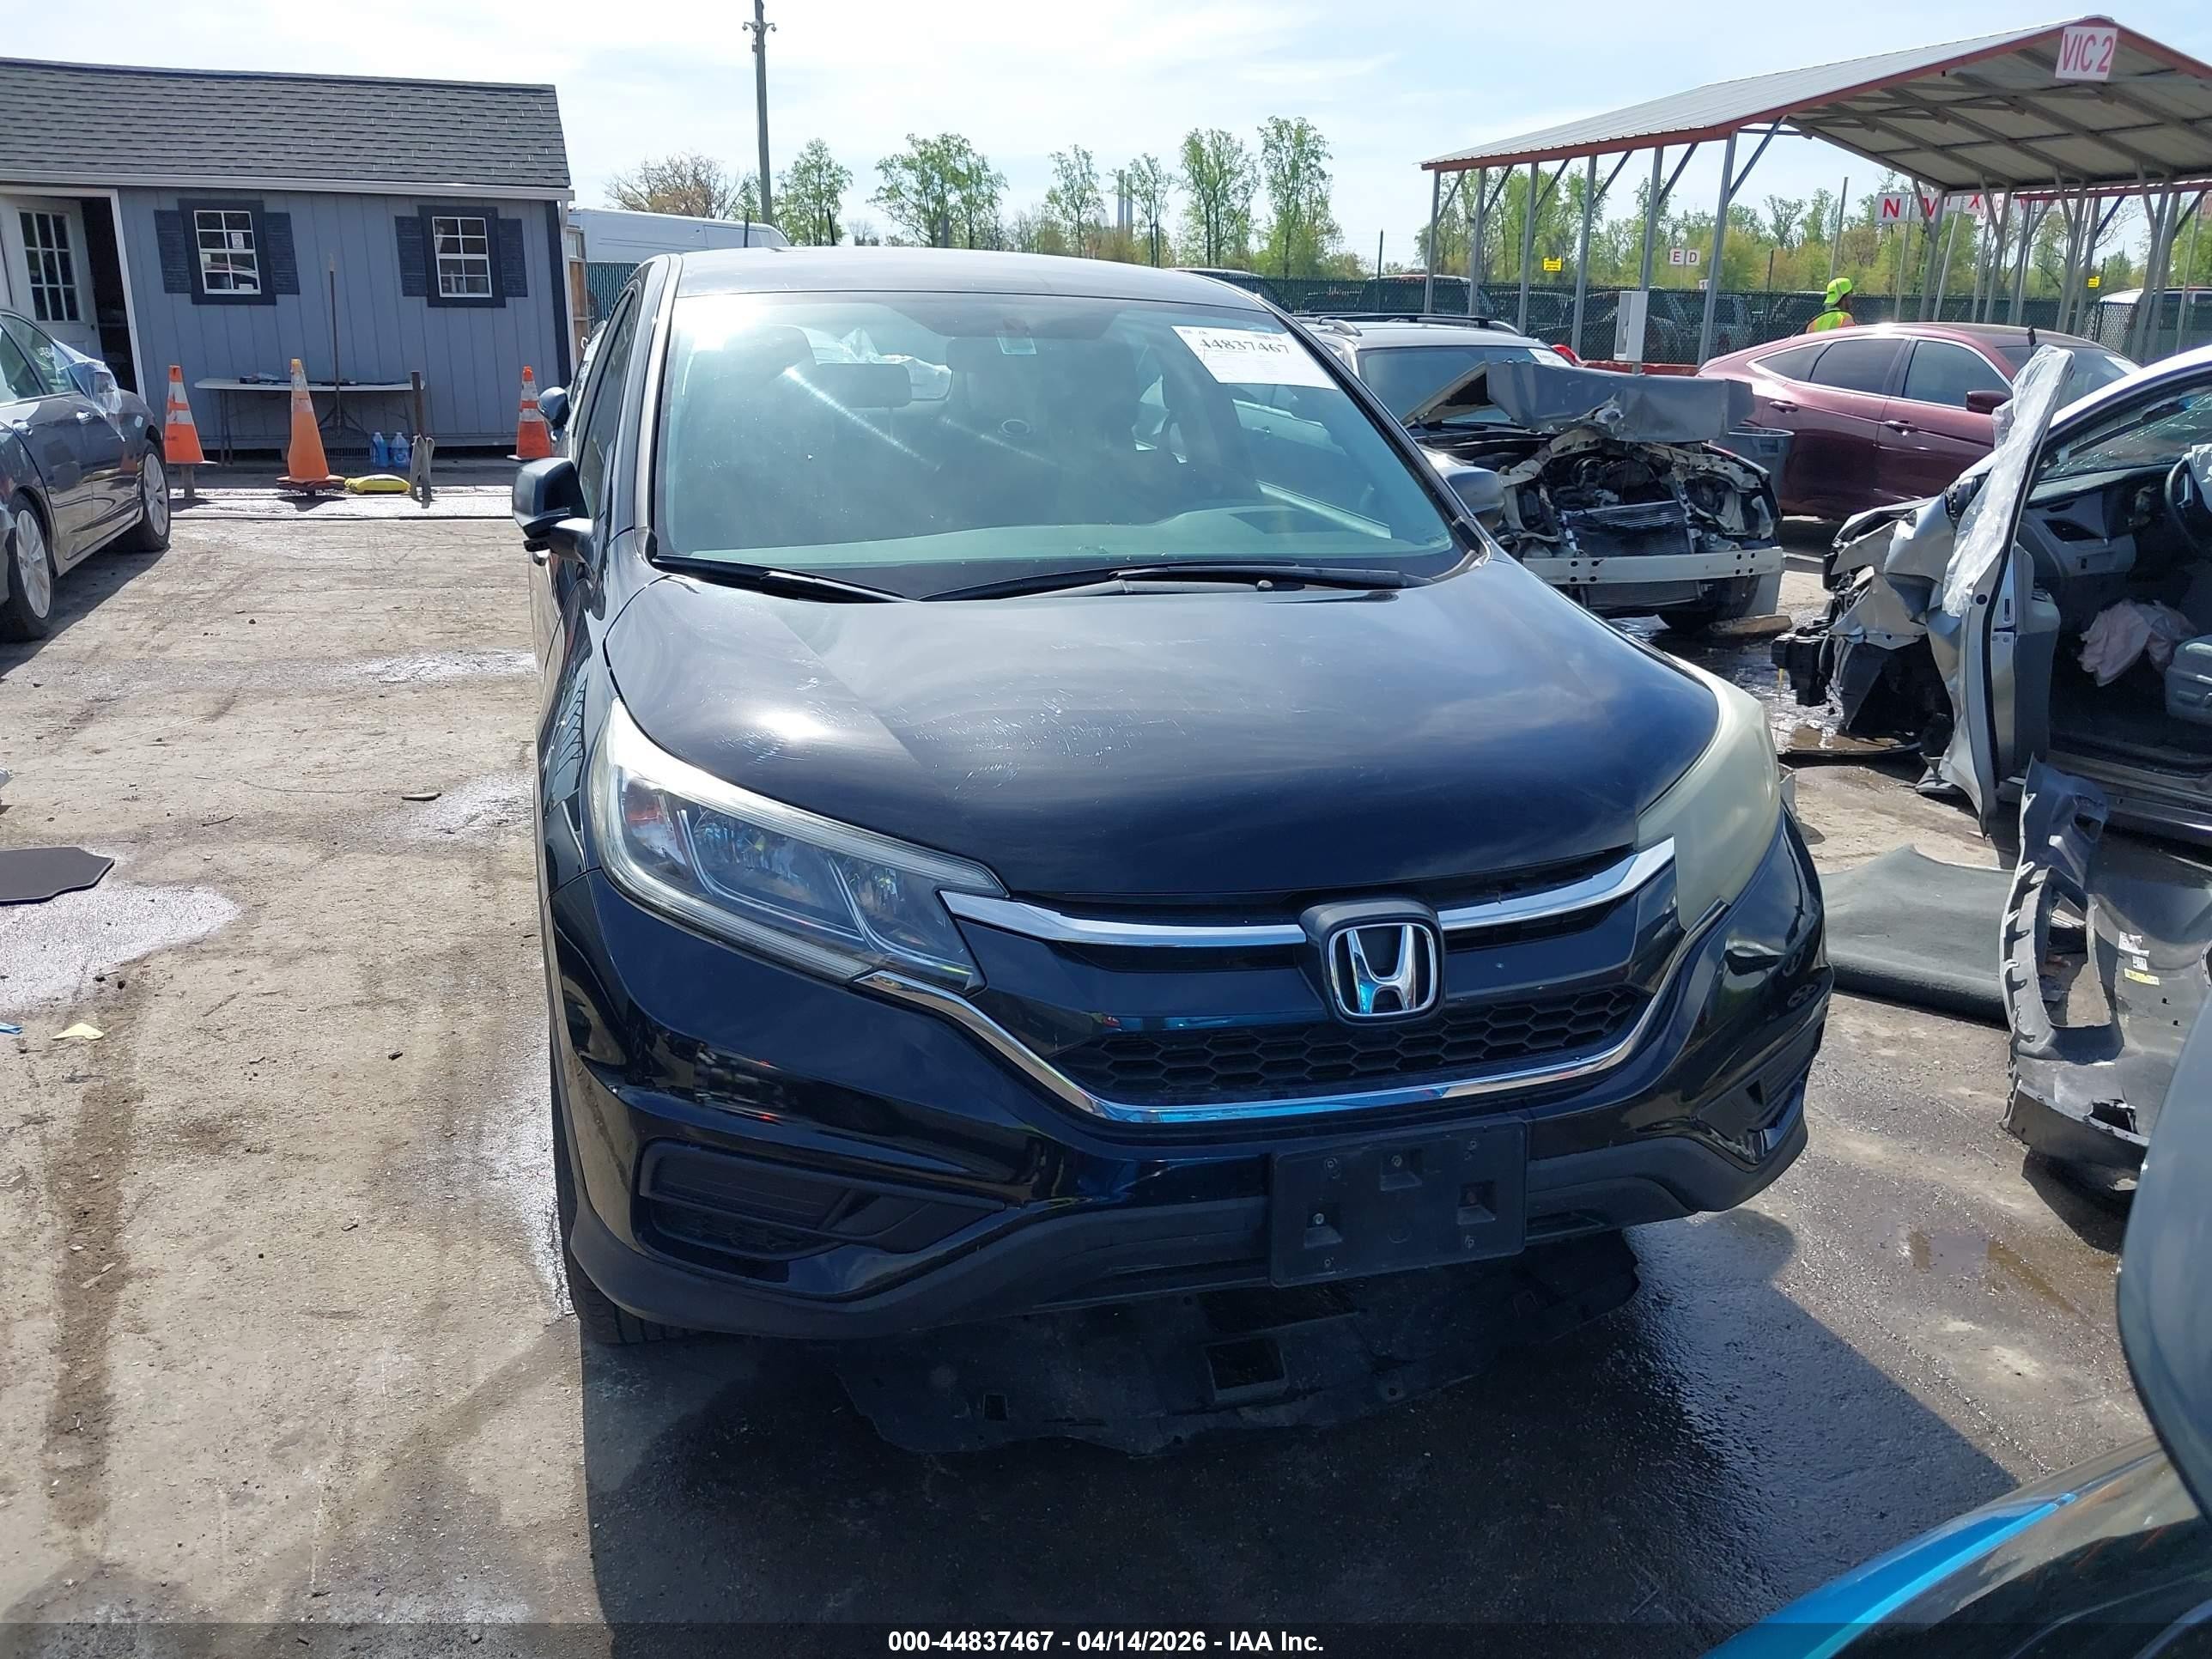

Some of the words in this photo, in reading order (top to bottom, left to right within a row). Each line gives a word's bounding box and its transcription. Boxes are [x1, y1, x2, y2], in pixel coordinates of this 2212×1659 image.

[2063, 33, 2096, 71] VIC
[2096, 34, 2113, 72] 2
[1882, 198, 1900, 218] N
[1673, 251, 1680, 262] E
[1689, 252, 1698, 263] D
[1200, 338, 1290, 354] 44837467
